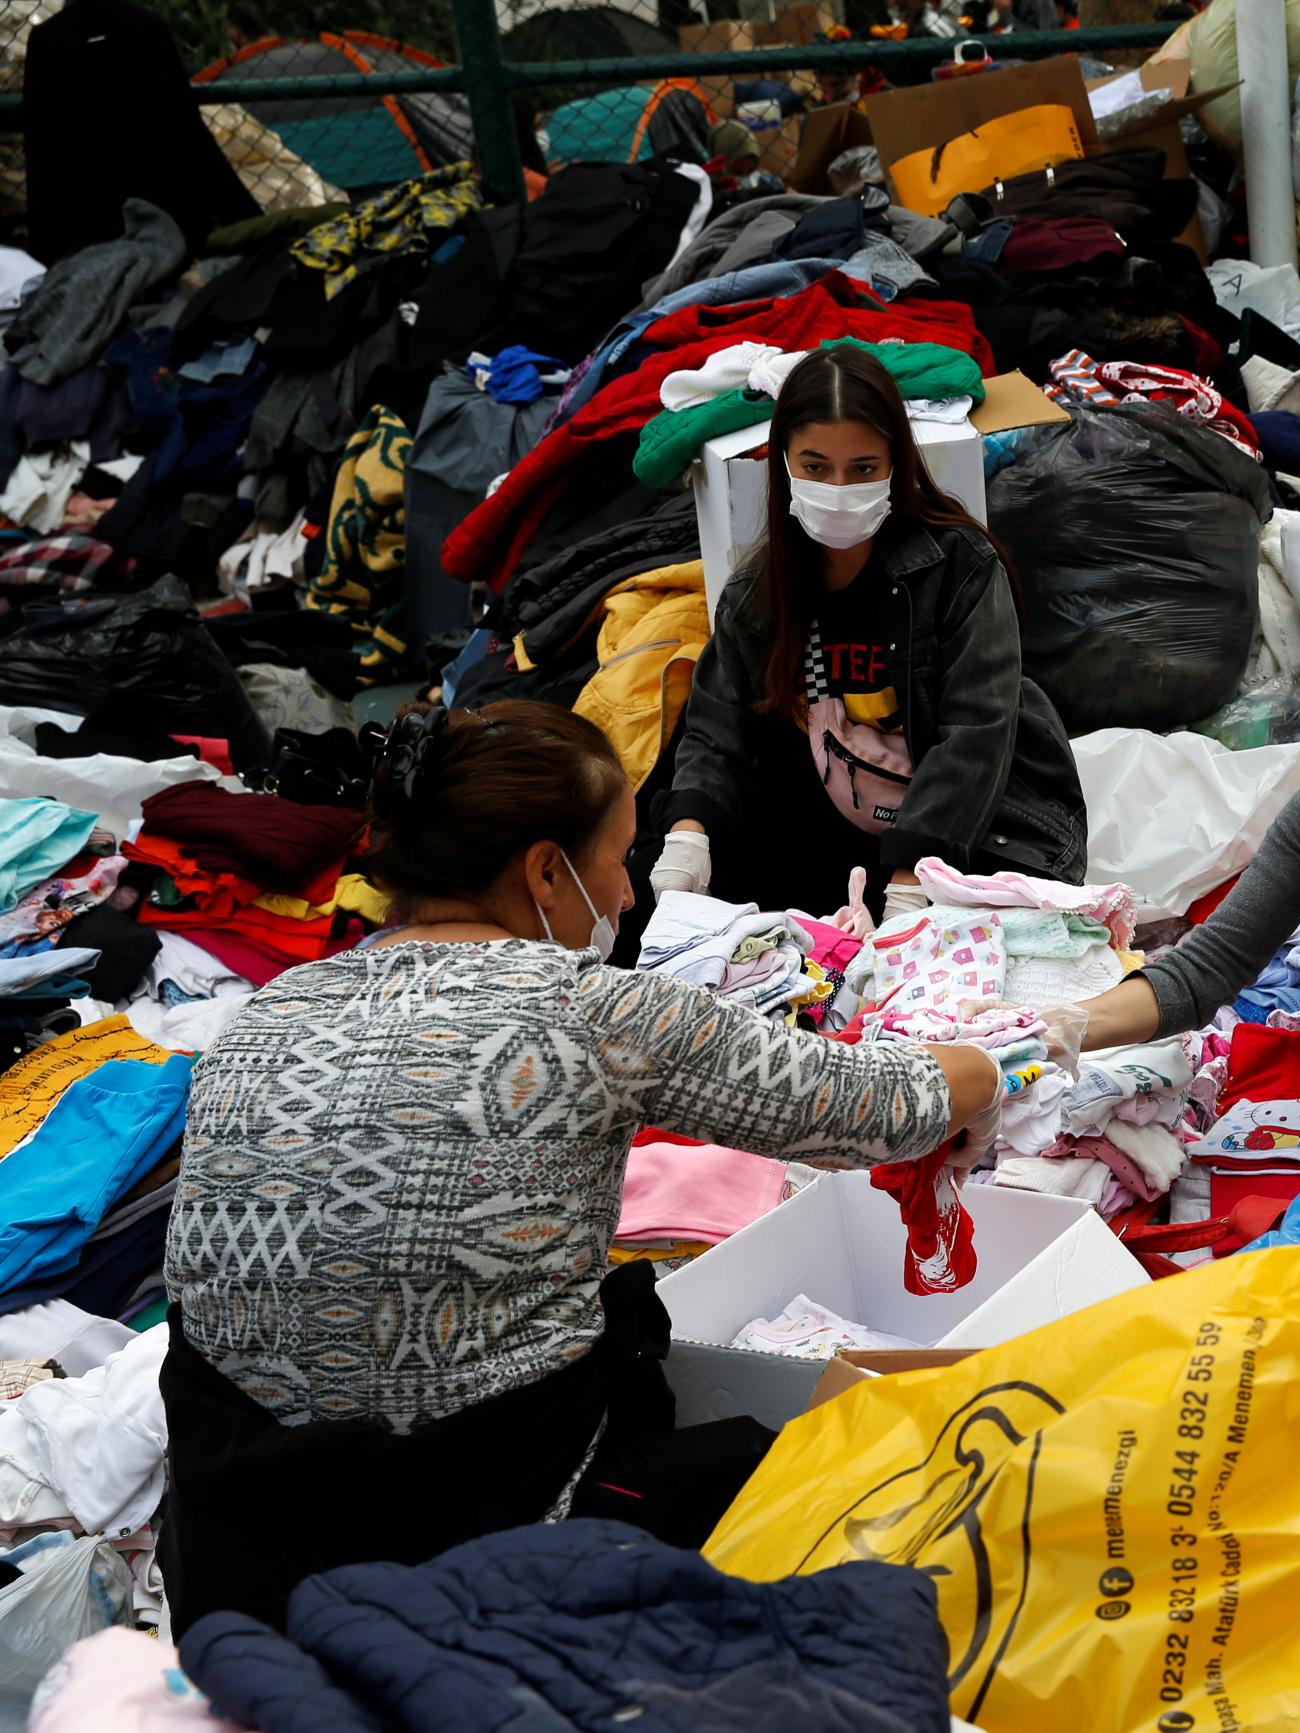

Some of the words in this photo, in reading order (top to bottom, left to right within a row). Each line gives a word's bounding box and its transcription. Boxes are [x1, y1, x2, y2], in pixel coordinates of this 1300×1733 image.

[875, 808, 890, 820] No
[891, 810, 899, 820] F
[1196, 1321, 1223, 1348] 59
[1187, 1355, 1215, 1383] 55
[1178, 1389, 1209, 1441] 832
[1226, 1349, 1257, 1444] Menemen
[1167, 1450, 1200, 1517] 0544
[1171, 1526, 1198, 1547] 3
[1212, 1577, 1240, 1647] Atatürk
[1160, 1633, 1189, 1702] 0232
[1205, 1652, 1224, 1697] Mah.
